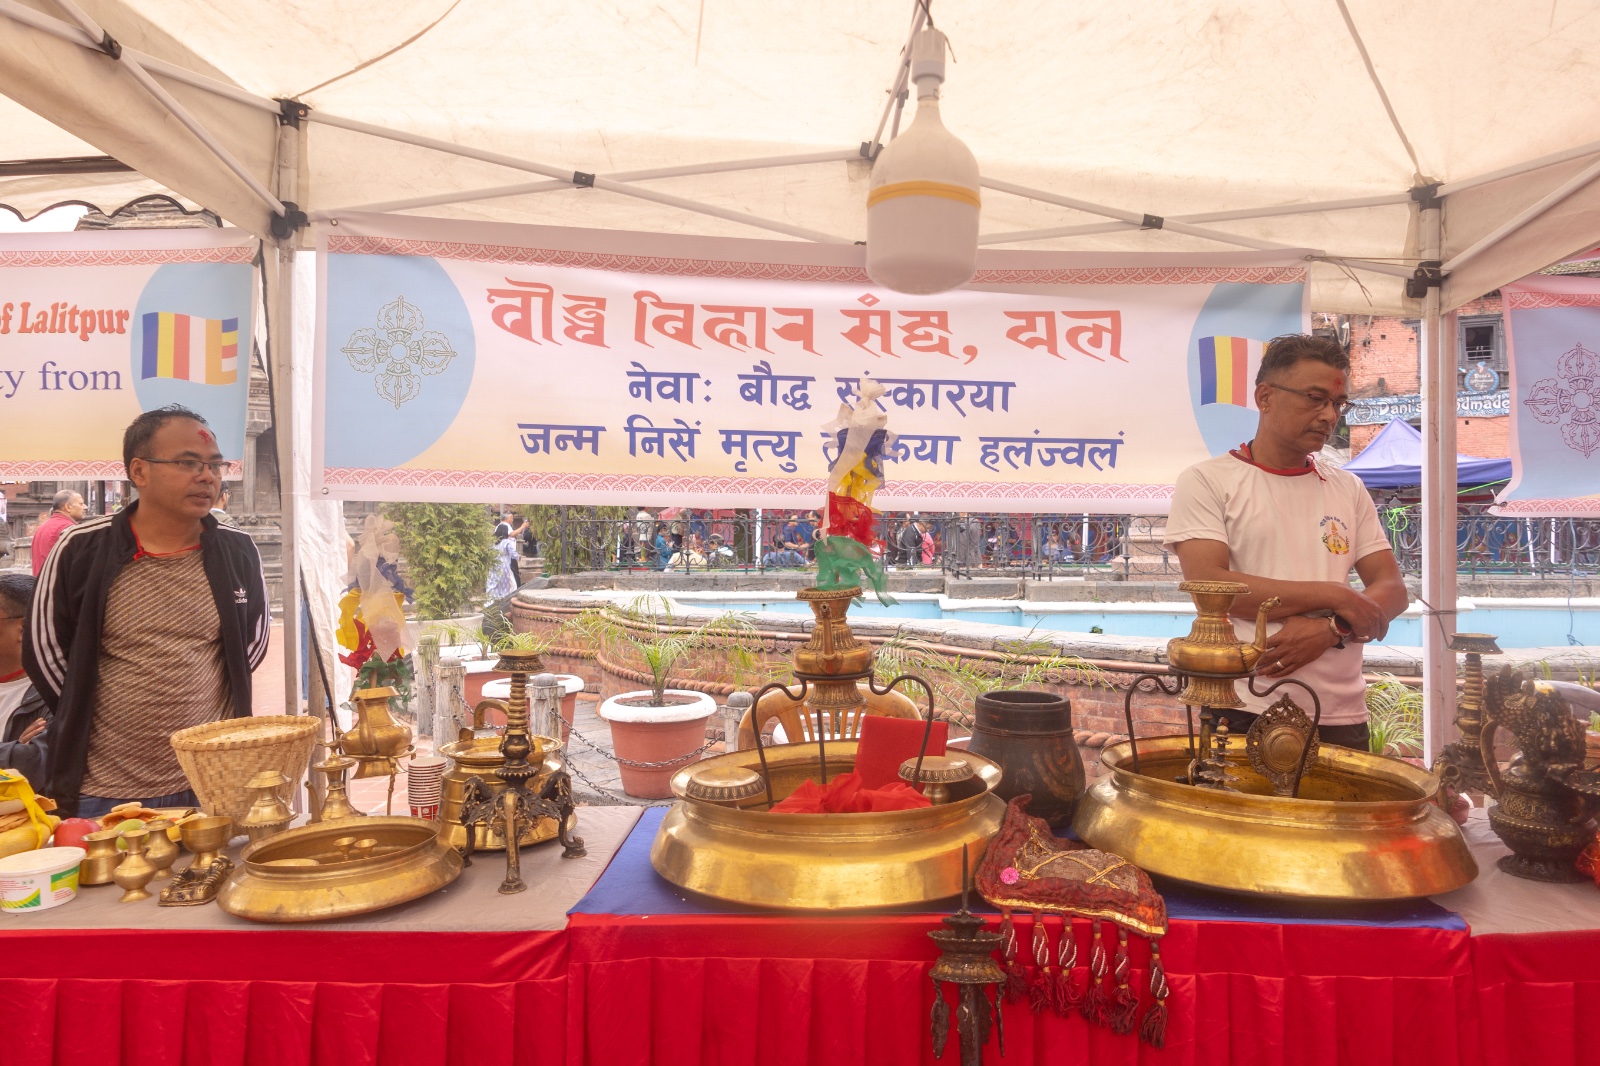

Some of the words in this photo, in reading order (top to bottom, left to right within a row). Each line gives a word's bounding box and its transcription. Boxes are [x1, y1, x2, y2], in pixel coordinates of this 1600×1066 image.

[0, 302, 14, 334] f
[17, 302, 130, 342] Lalitpur
[38, 361, 123, 391] from
[737, 360, 816, 411] बौद्ध
[1376, 398, 1422, 416] Dani's
[1457, 395, 1510, 412] dmade
[517, 423, 607, 456] जन्म
[718, 429, 803, 473] मृत्यु
